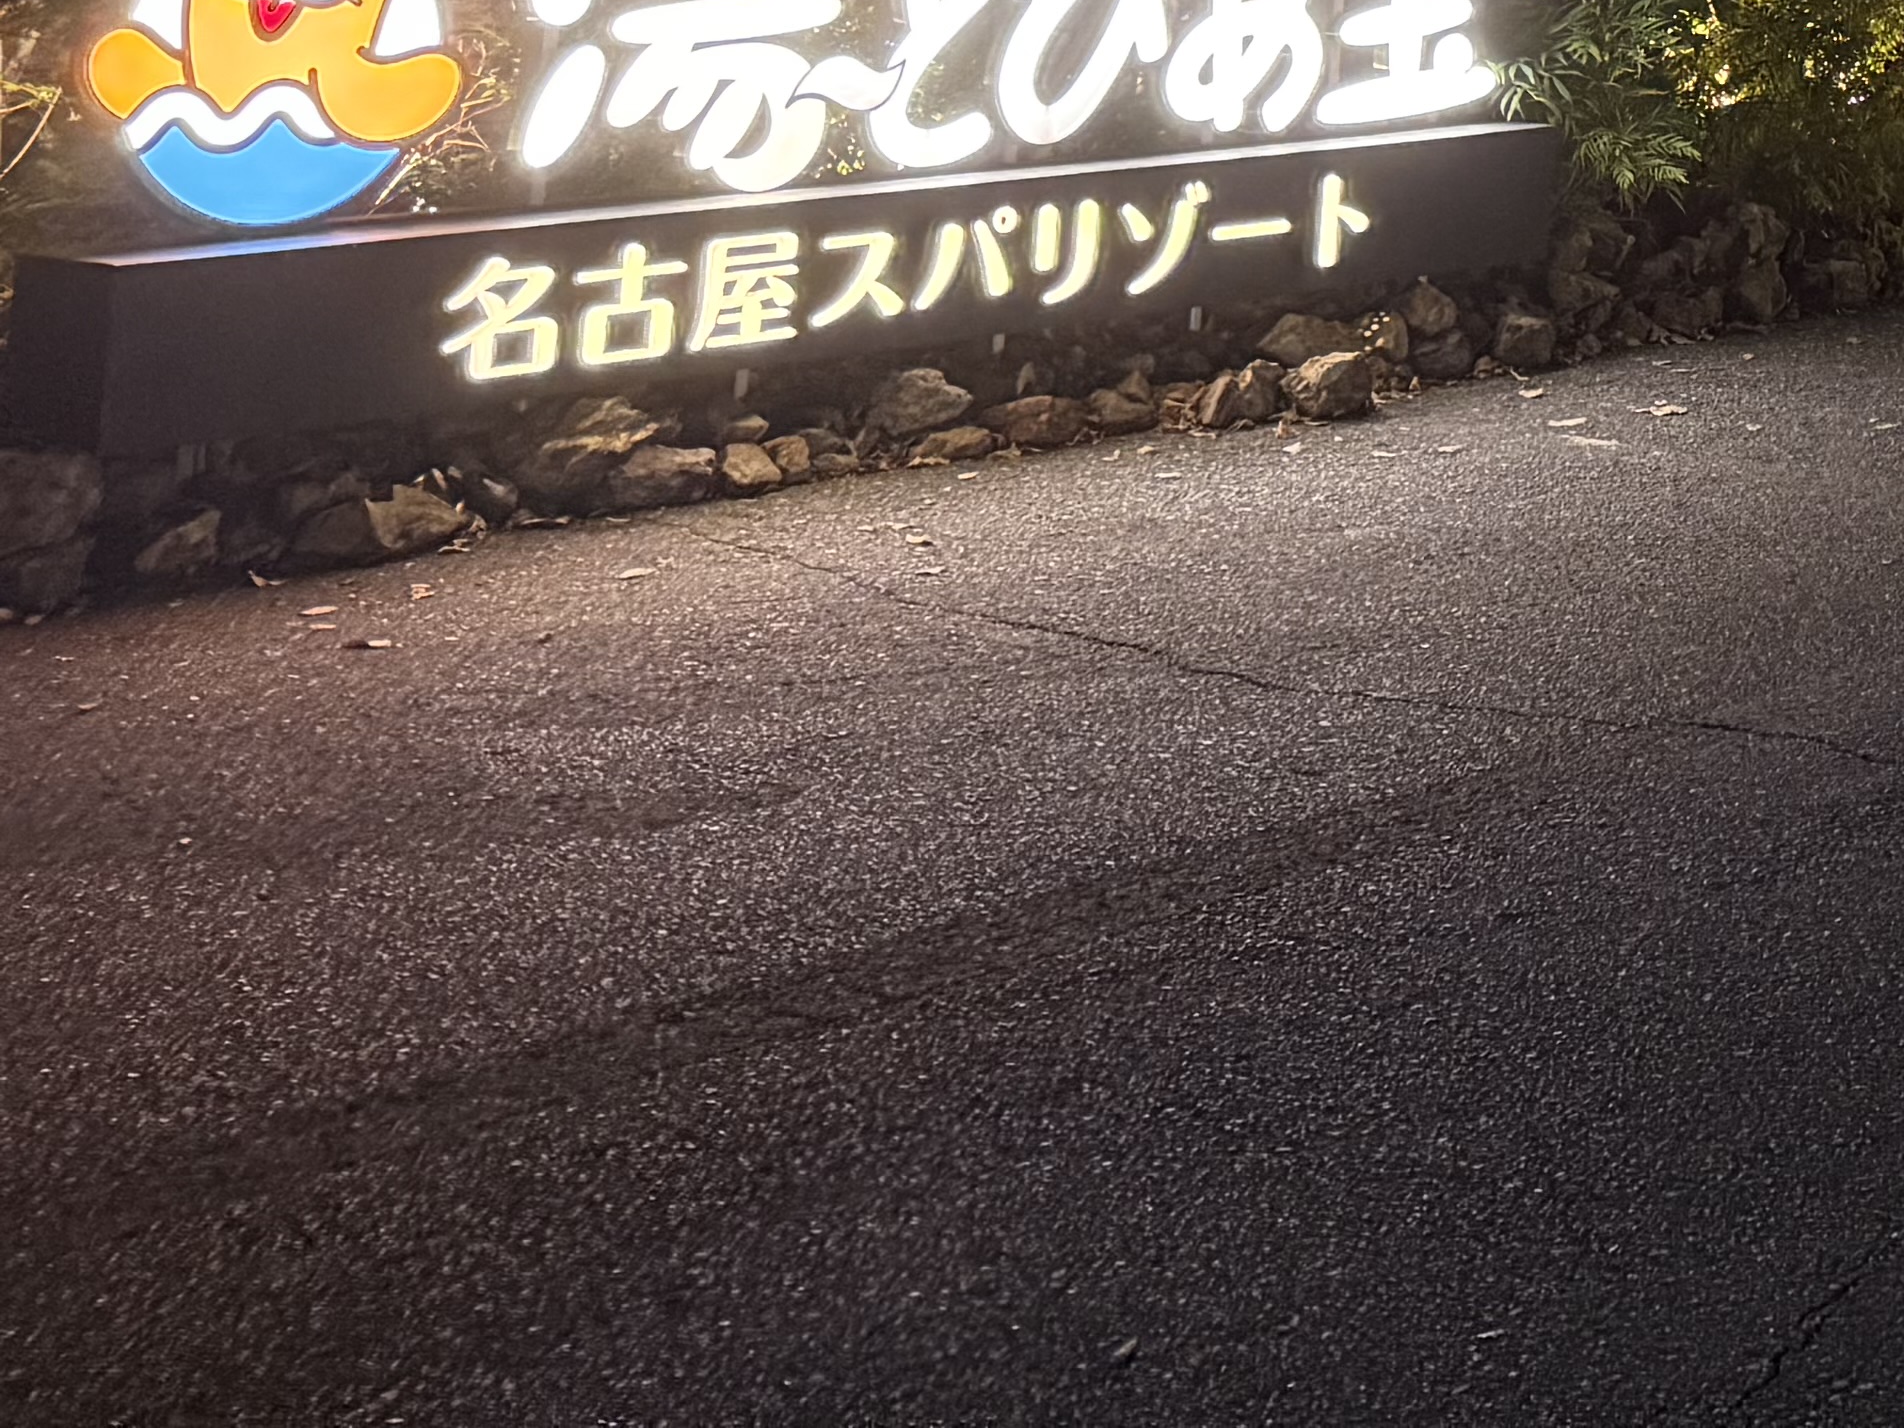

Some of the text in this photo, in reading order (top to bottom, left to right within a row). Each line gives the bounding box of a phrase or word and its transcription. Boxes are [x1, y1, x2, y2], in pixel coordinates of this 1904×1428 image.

[443, 174, 1371, 382] 名古屋スパリゾート
